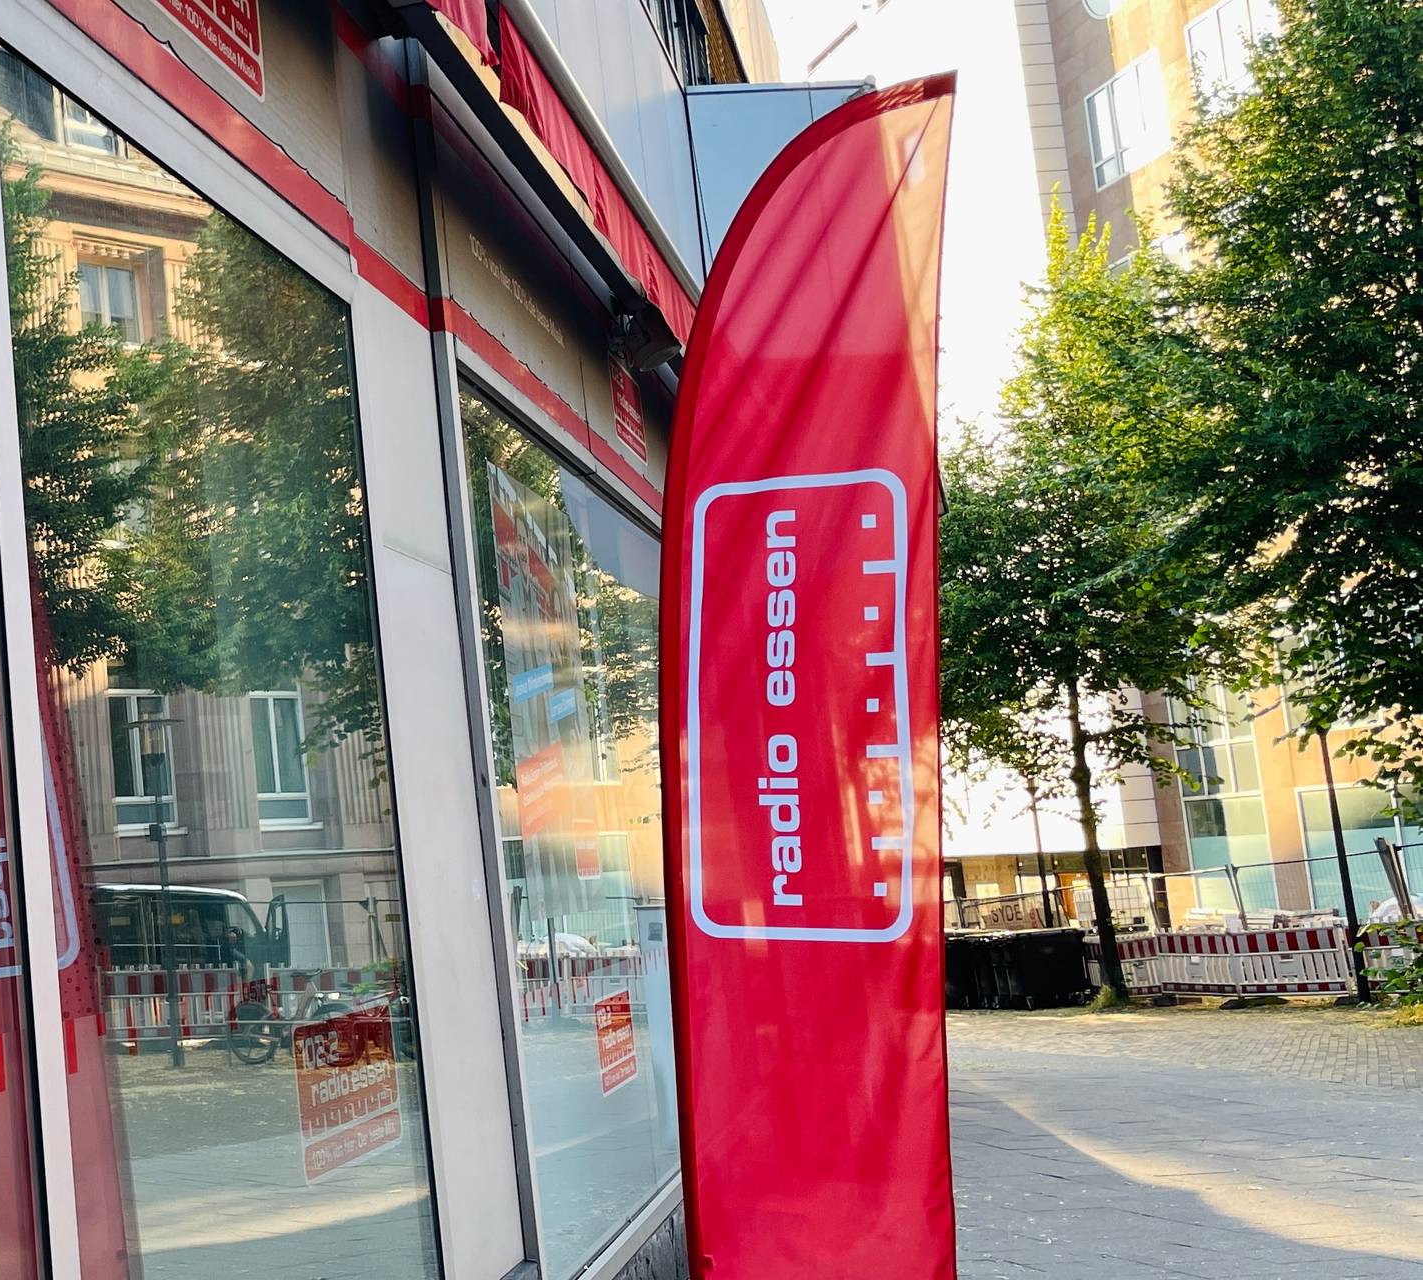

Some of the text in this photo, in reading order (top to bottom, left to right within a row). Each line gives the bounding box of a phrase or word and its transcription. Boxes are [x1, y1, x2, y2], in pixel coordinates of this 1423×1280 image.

[185, 4, 207, 37] 100%
[207, 26, 218, 46] die
[217, 34, 237, 65] beste
[757, 508, 804, 907] radio essen
[295, 1030, 339, 1072] 102.2
[310, 1058, 391, 1107] radio essen
